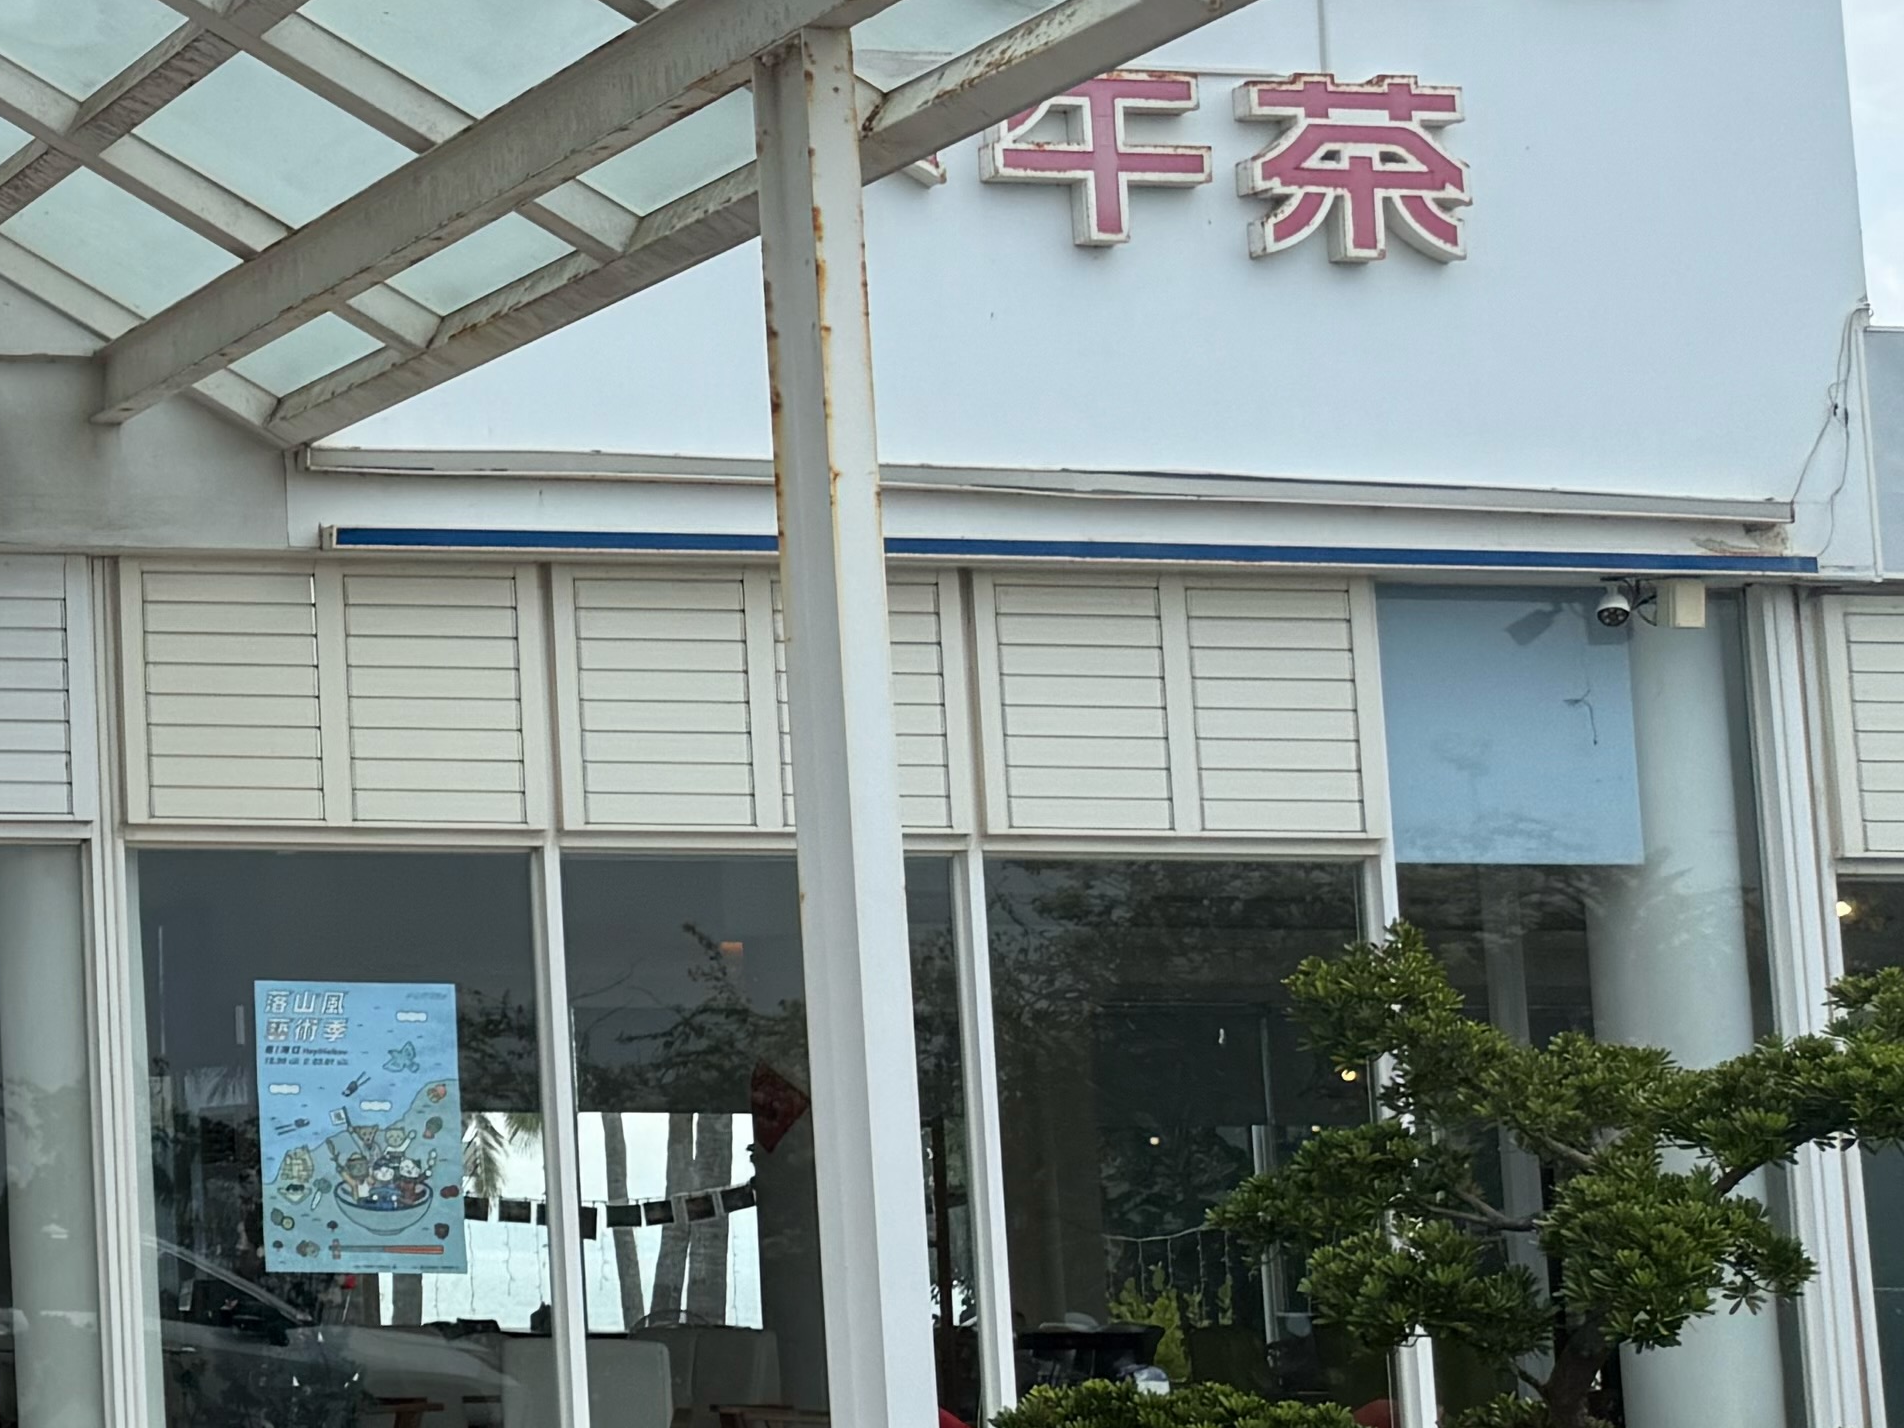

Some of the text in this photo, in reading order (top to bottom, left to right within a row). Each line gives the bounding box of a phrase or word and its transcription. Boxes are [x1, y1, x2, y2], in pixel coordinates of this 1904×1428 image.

[914, 69, 1473, 264] 午茶
[265, 990, 349, 1014] 落山風
[265, 1017, 349, 1042] 藝術季
